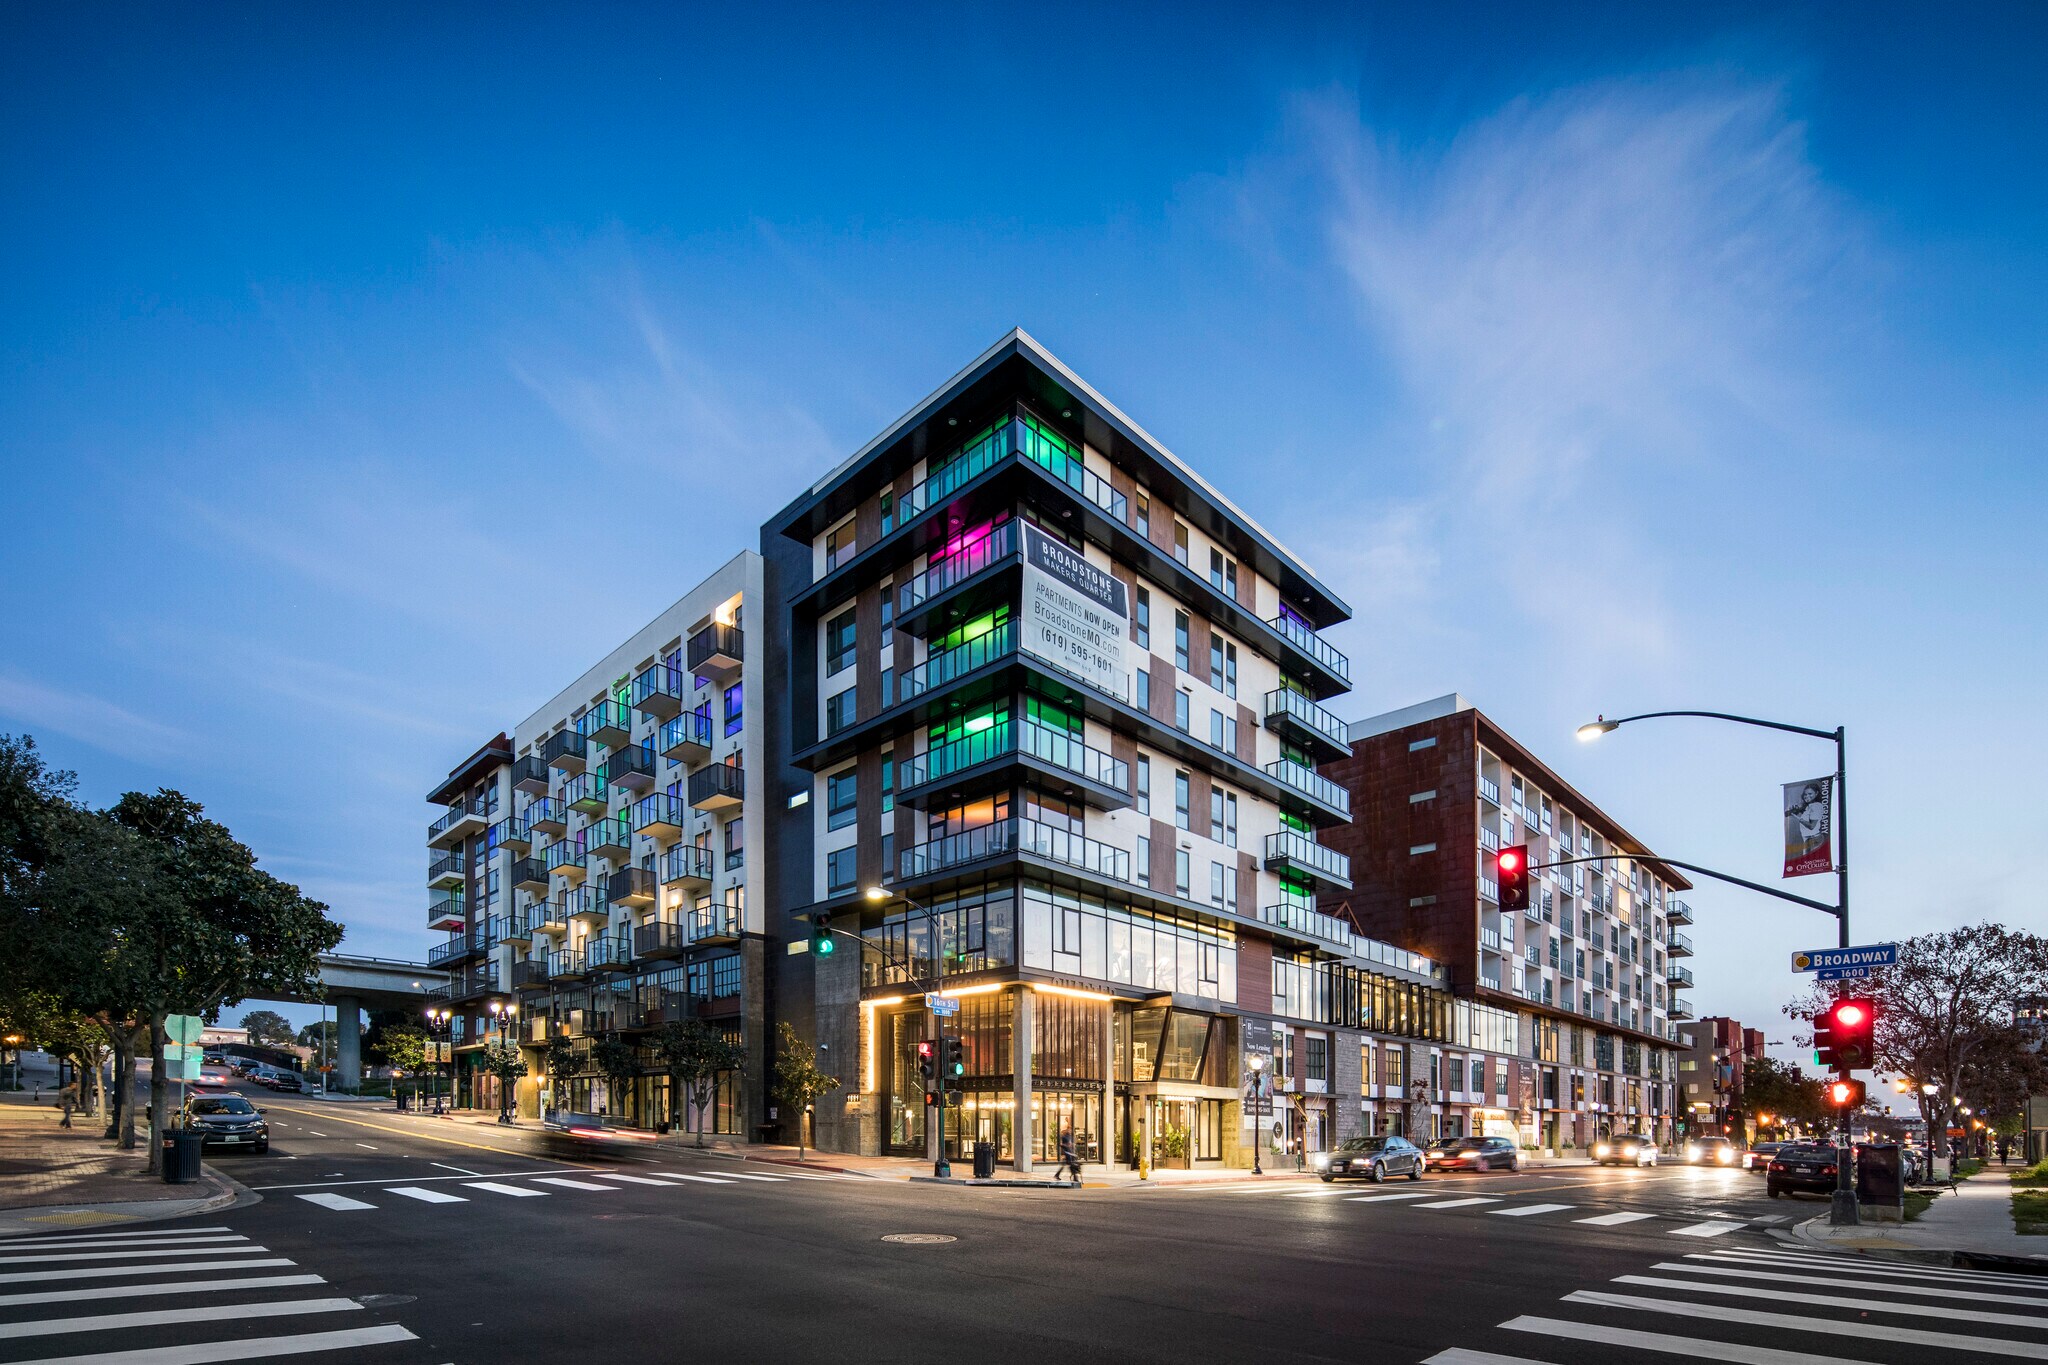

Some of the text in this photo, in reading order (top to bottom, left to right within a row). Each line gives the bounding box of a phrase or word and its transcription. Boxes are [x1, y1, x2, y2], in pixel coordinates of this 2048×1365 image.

[1042, 541, 1112, 593] BROADSTONE
[1044, 556, 1113, 604] MAKERS QUARTER
[1034, 600, 1120, 657] BroadstoneMQ.com
[1036, 582, 1120, 638] APARTMENTS NOW OPEN
[1041, 626, 1067, 652] (619)
[1071, 643, 1112, 674] 595-1601
[1821, 779, 1829, 834] PHOTOGRAPHY
[1813, 950, 1890, 967] BROADWAY
[1841, 968, 1864, 978] 1600
[1246, 1042, 1271, 1053] Now Leasing
